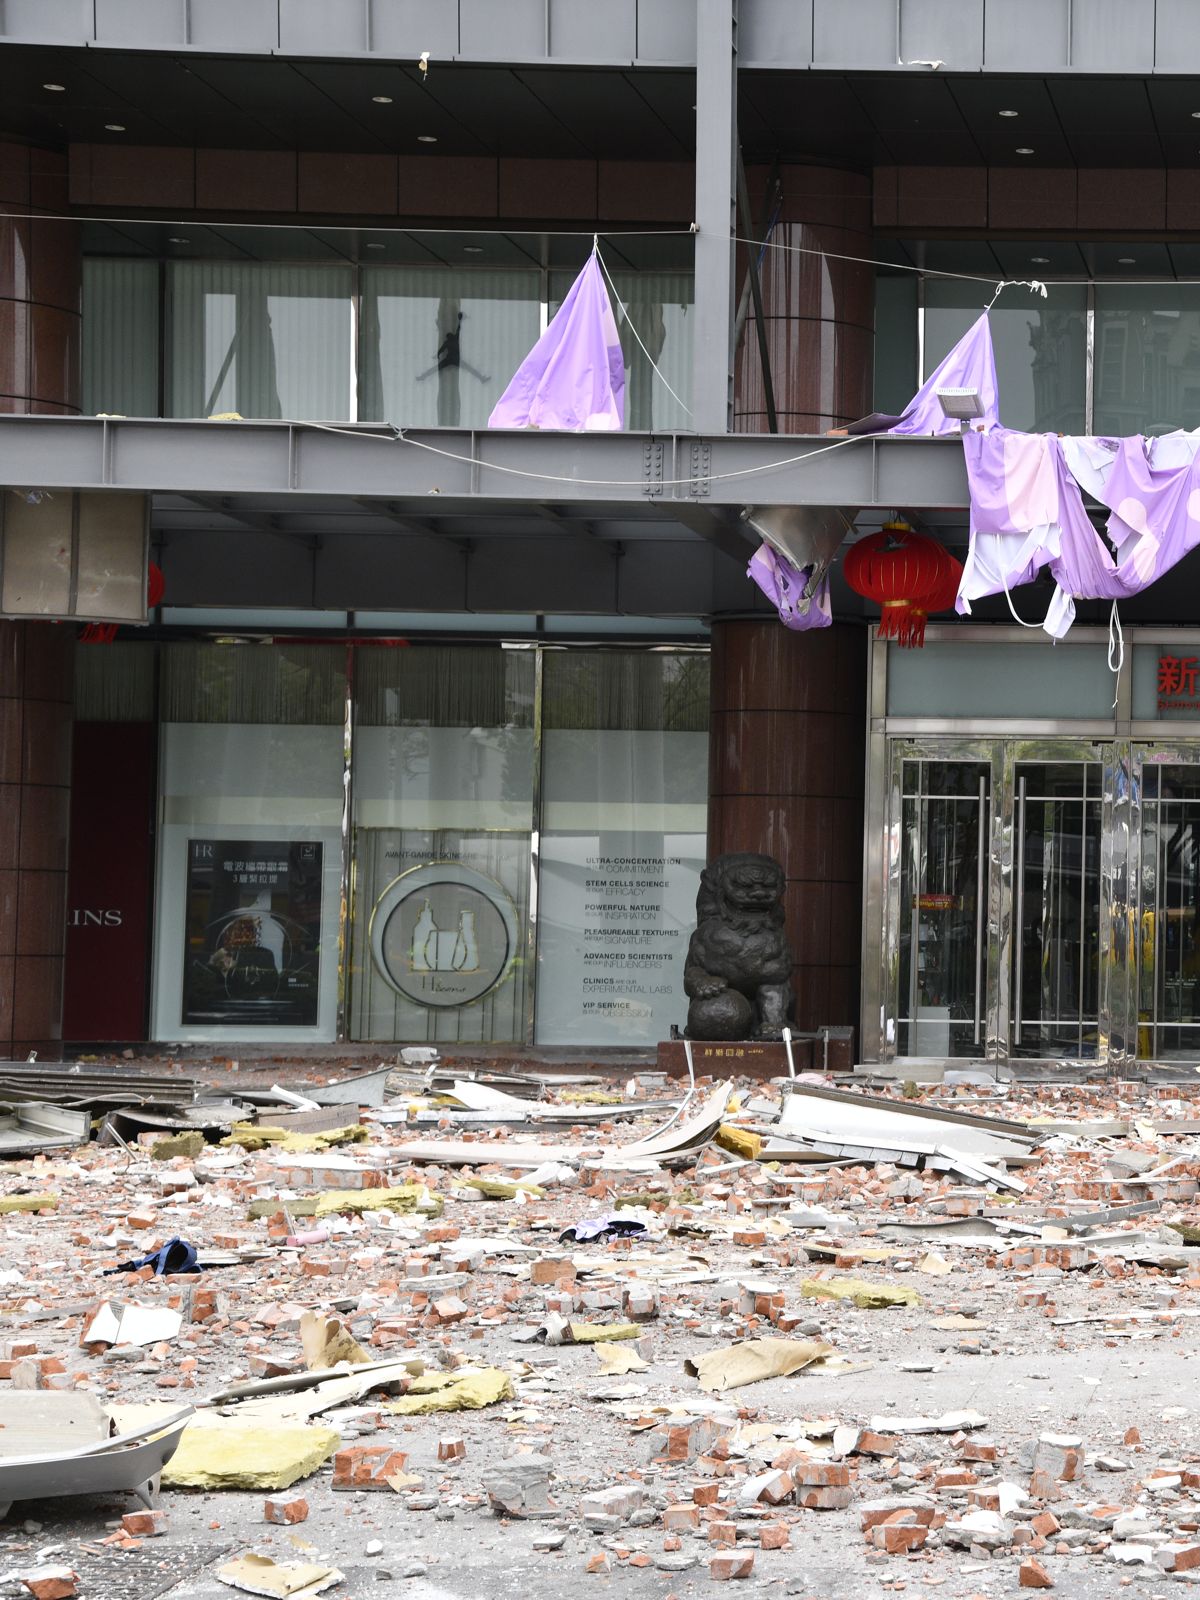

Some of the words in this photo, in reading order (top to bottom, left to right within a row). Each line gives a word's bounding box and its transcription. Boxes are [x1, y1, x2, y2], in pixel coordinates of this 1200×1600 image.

[586, 857, 681, 865] ULTRA-CONCENTRATION
[605, 865, 664, 874] COMMITMENT
[635, 880, 670, 888] SCIENCE
[605, 887, 646, 896] EFFICACY
[629, 904, 661, 912] NATURE
[67, 909, 122, 926] INS
[604, 911, 657, 920] INSPIRATION
[584, 928, 641, 936] PLEASUREABLE
[642, 929, 679, 937] TEXTURES
[604, 936, 652, 945] SIGNATURE
[627, 953, 673, 961] SCIENTISTS
[603, 960, 663, 969] INFLUENCERS
[583, 977, 615, 985] CLINICS
[582, 985, 647, 994] EXPERIMENTAL
[649, 985, 673, 994] LABS
